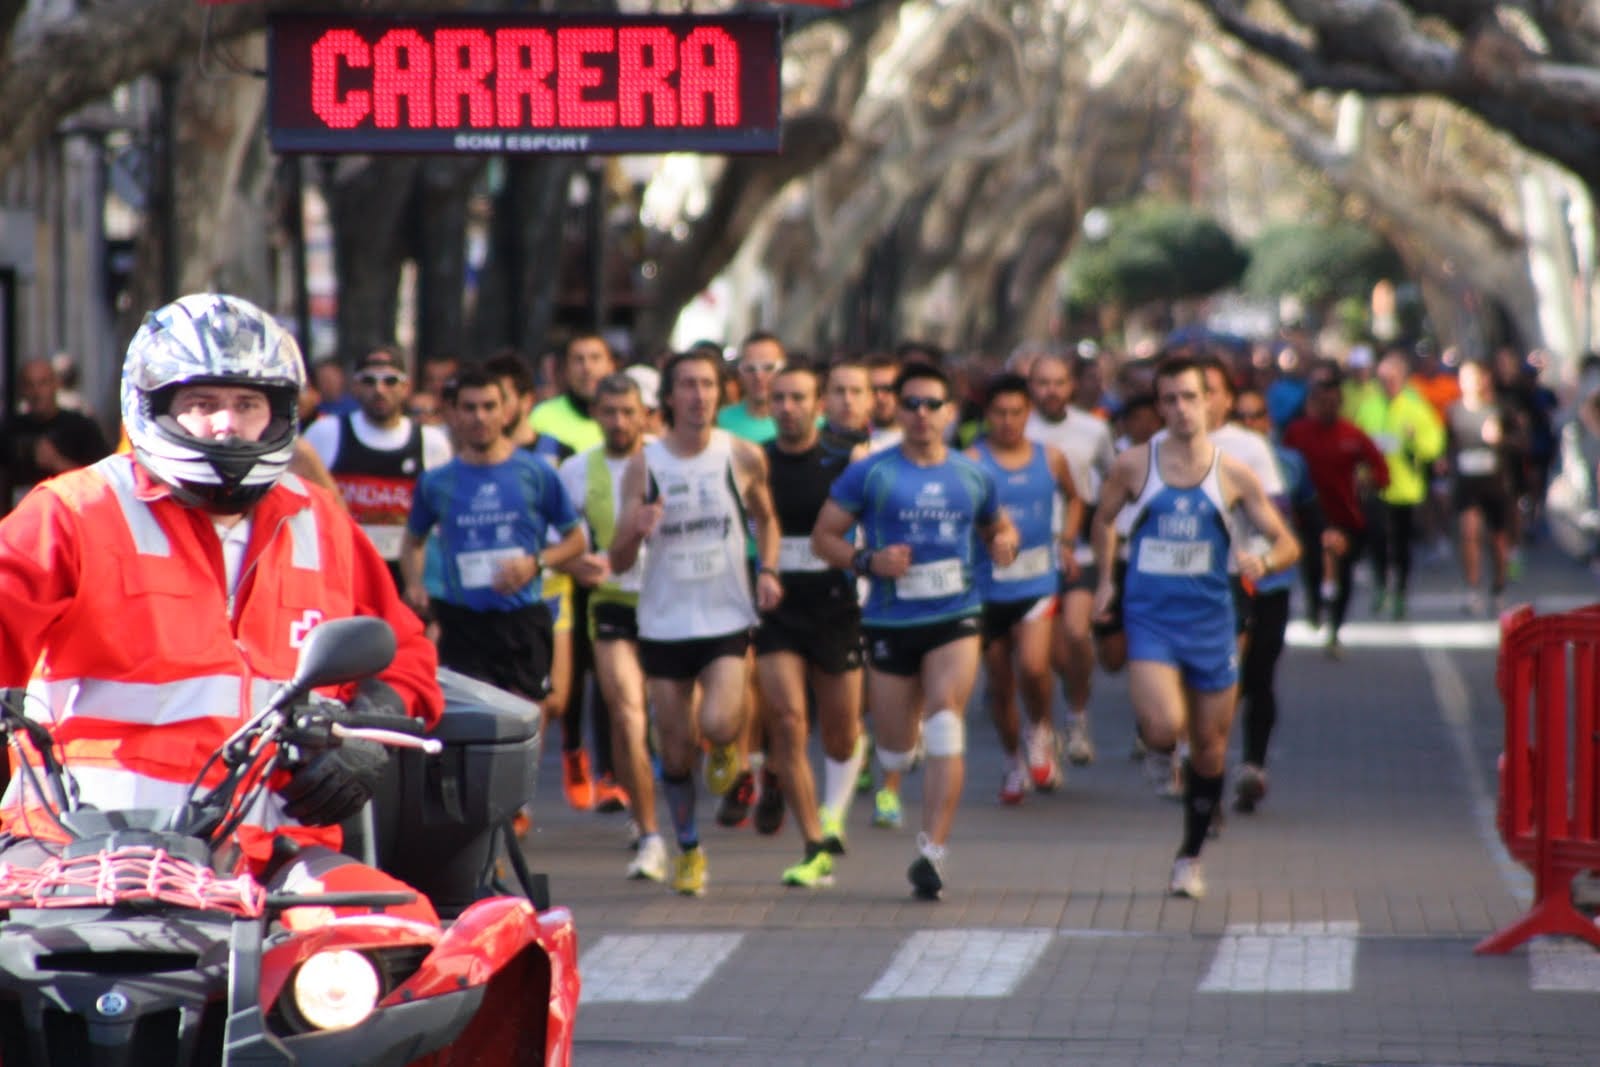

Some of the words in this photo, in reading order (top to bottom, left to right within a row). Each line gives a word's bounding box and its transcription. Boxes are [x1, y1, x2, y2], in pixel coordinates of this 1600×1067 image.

[312, 27, 739, 128] CARRERA
[454, 134, 501, 150] SOM
[506, 134, 589, 150] ESPORT
